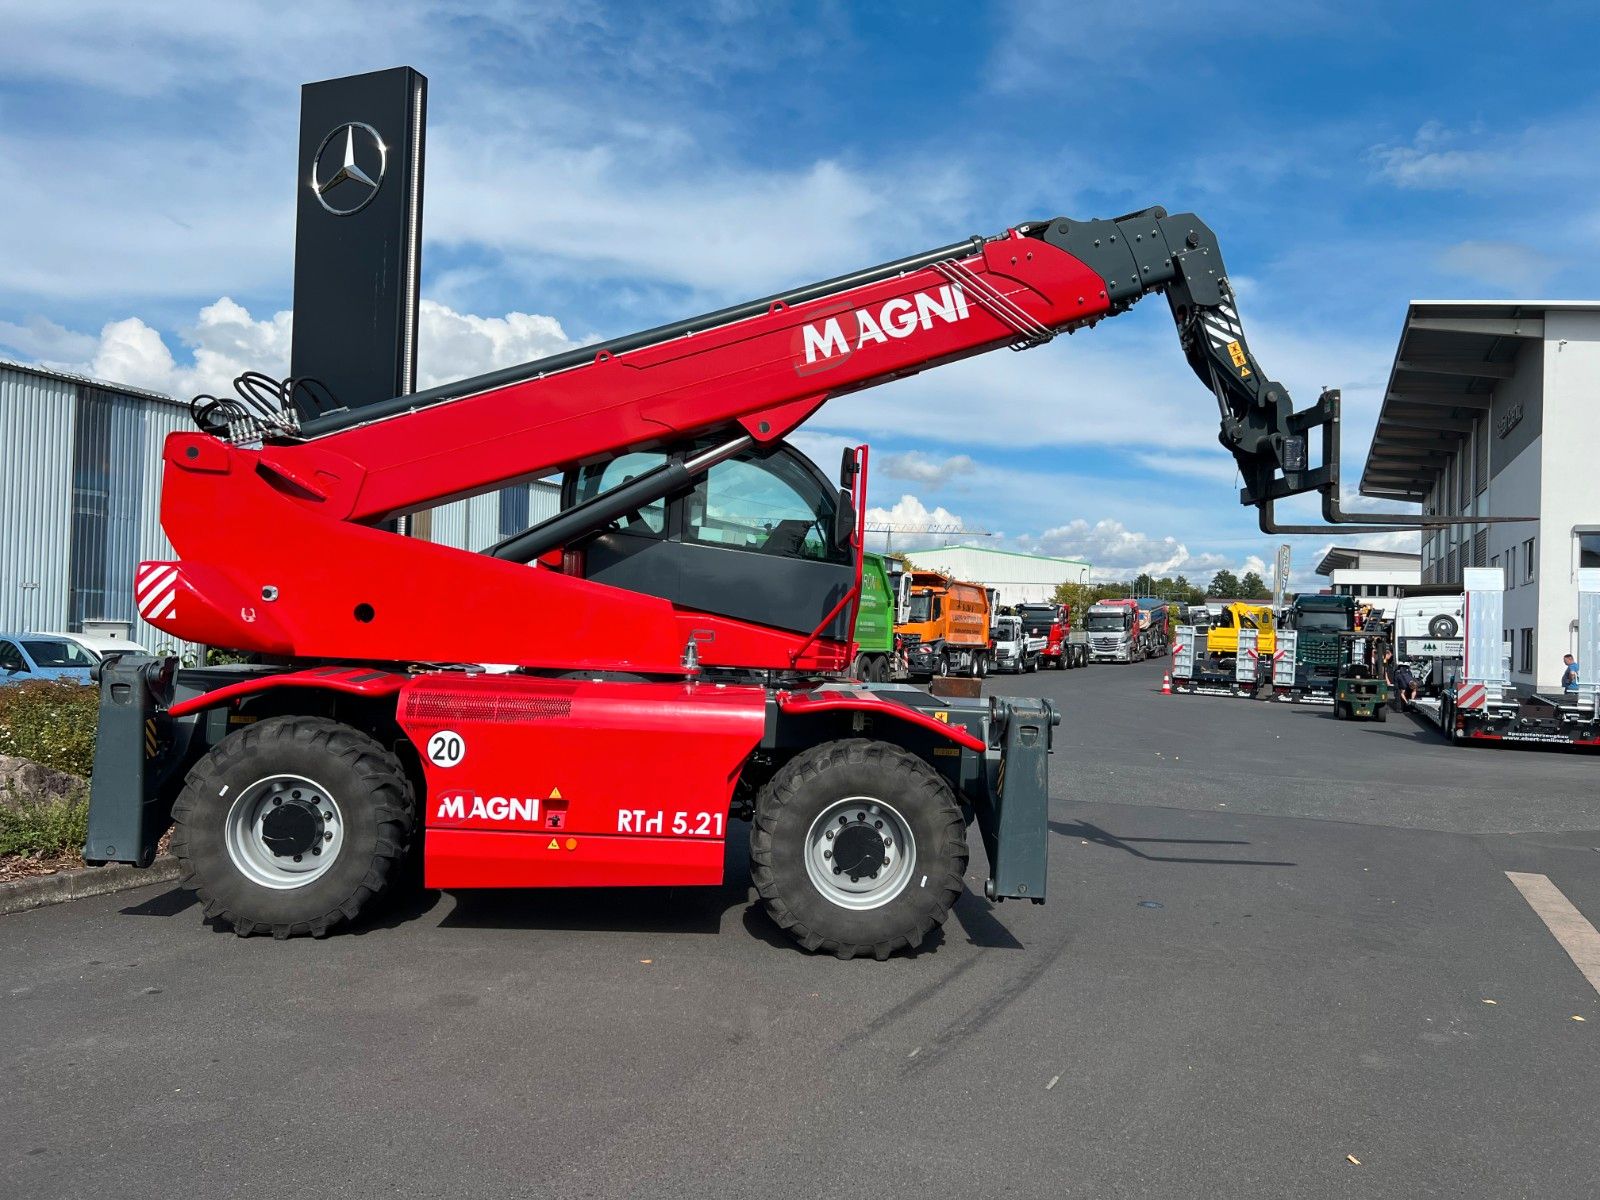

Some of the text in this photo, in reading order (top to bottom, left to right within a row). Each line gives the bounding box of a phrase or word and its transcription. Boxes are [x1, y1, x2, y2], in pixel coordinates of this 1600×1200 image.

[802, 282, 970, 364] MAGNI
[432, 737, 460, 761] 20
[437, 795, 540, 822] MAGNI
[672, 811, 724, 836] 5.21
